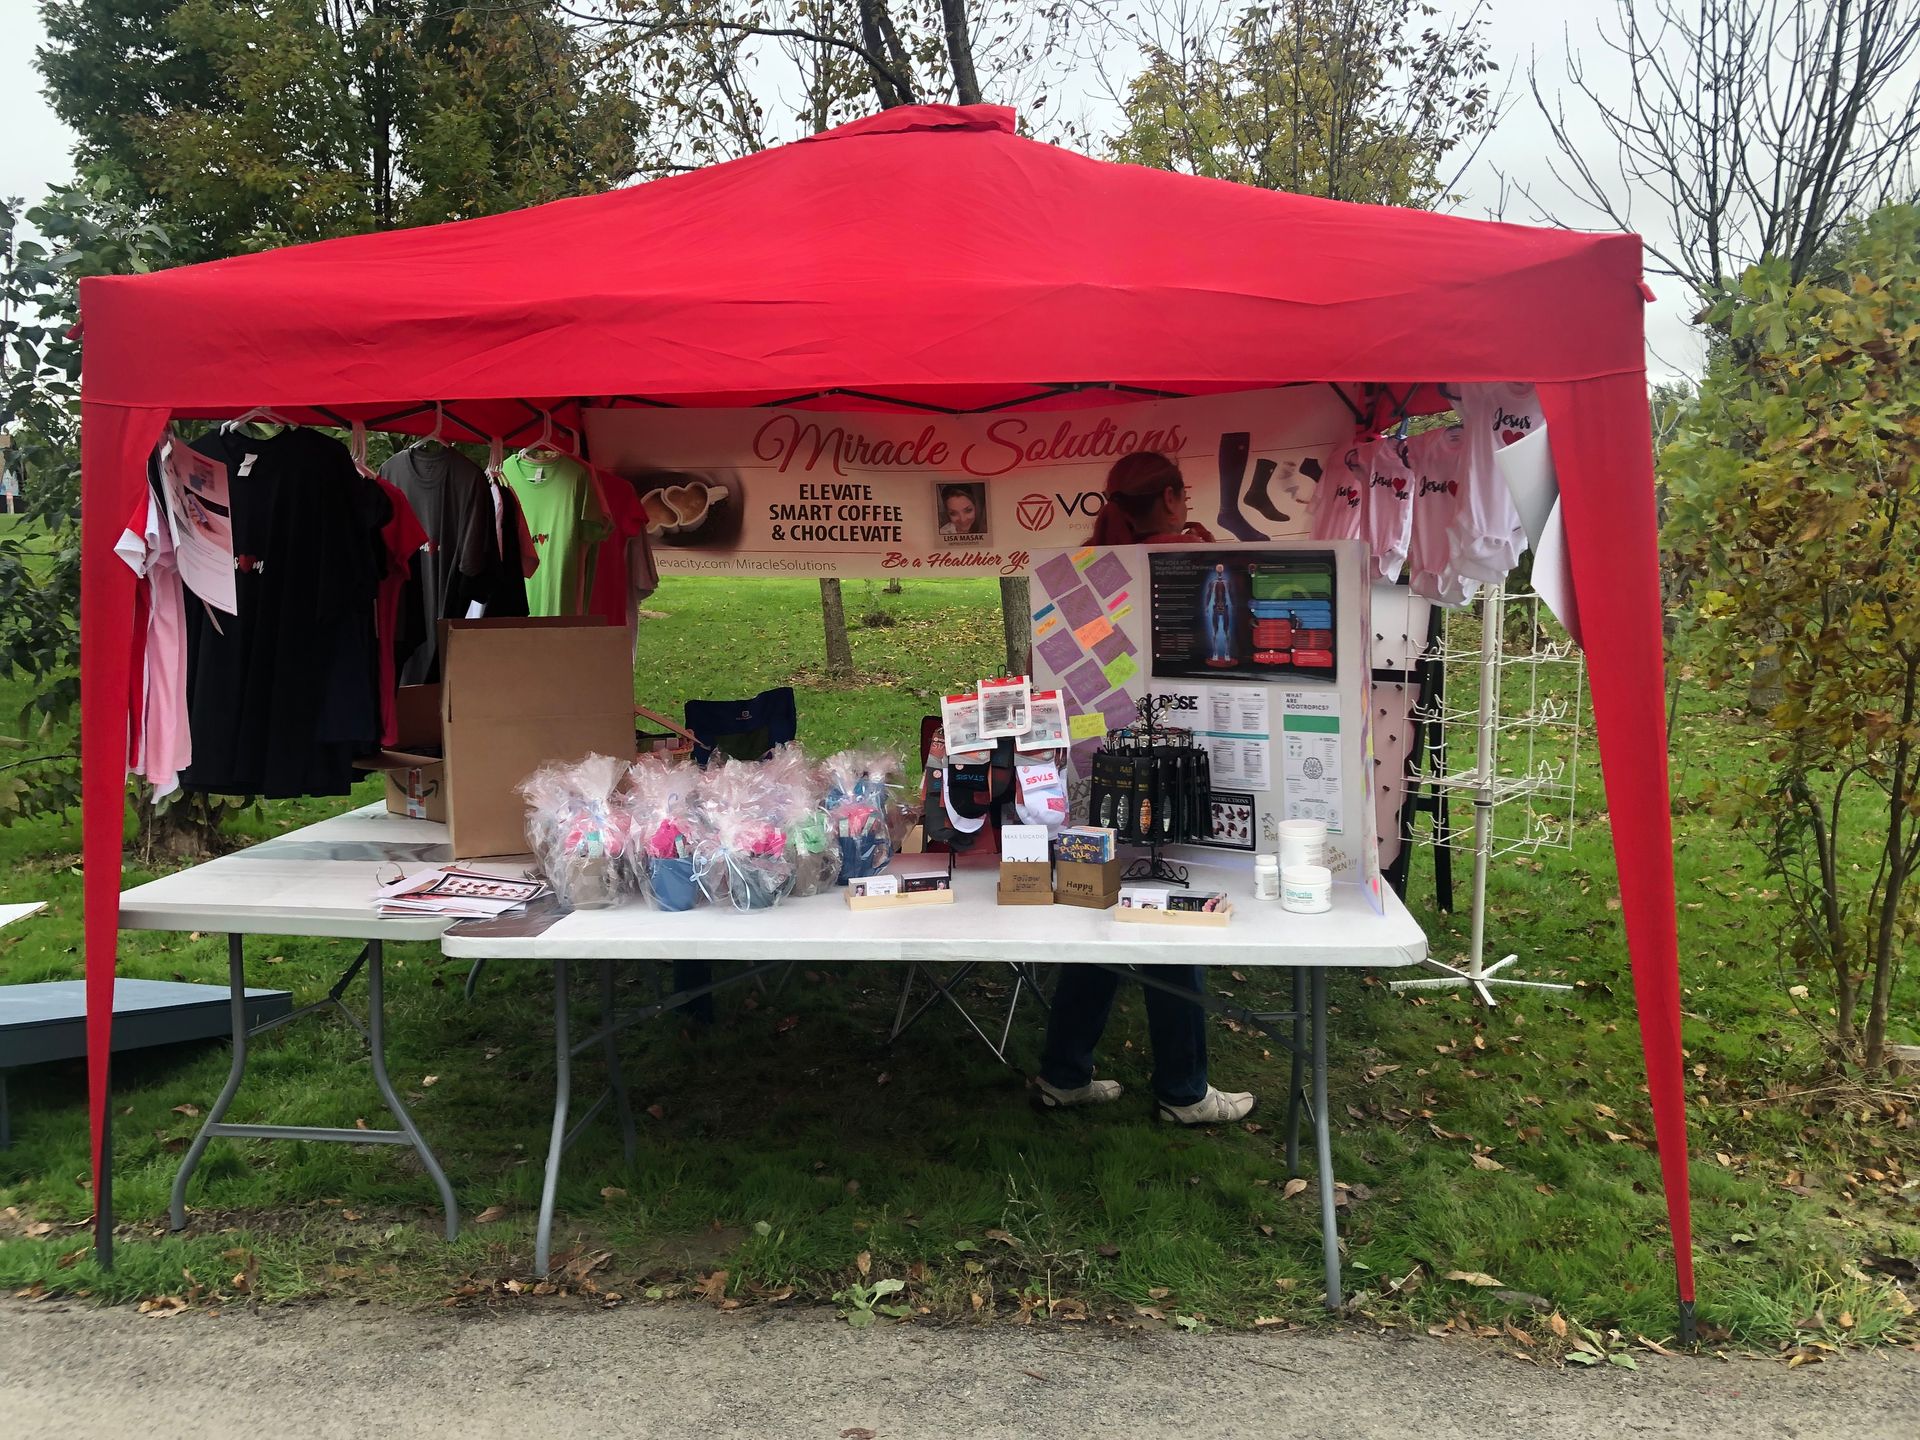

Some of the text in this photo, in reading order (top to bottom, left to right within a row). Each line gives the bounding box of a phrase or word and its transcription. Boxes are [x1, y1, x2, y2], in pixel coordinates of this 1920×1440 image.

[1492, 407, 1531, 431] Jesus
[753, 414, 1188, 477] Miracle Solutions
[1369, 471, 1393, 488] Jesus
[1419, 475, 1447, 498] Jesus
[799, 484, 873, 501] ELEVATE
[769, 504, 903, 522] SMART COFFEE
[771, 524, 902, 542] & CHOCLEVATE
[959, 534, 984, 542] MASAK
[656, 556, 837, 571] levacity.com/MiracleSolutions
[881, 551, 910, 569] Be
[912, 557, 922, 568] a
[926, 551, 1003, 568] Healthier
[955, 774, 985, 782] STASIS
[1025, 772, 1054, 785] STASIS
[1060, 843, 1101, 854] PUMPKIN
[1071, 851, 1091, 859] TALE
[1066, 881, 1094, 892] Happy
